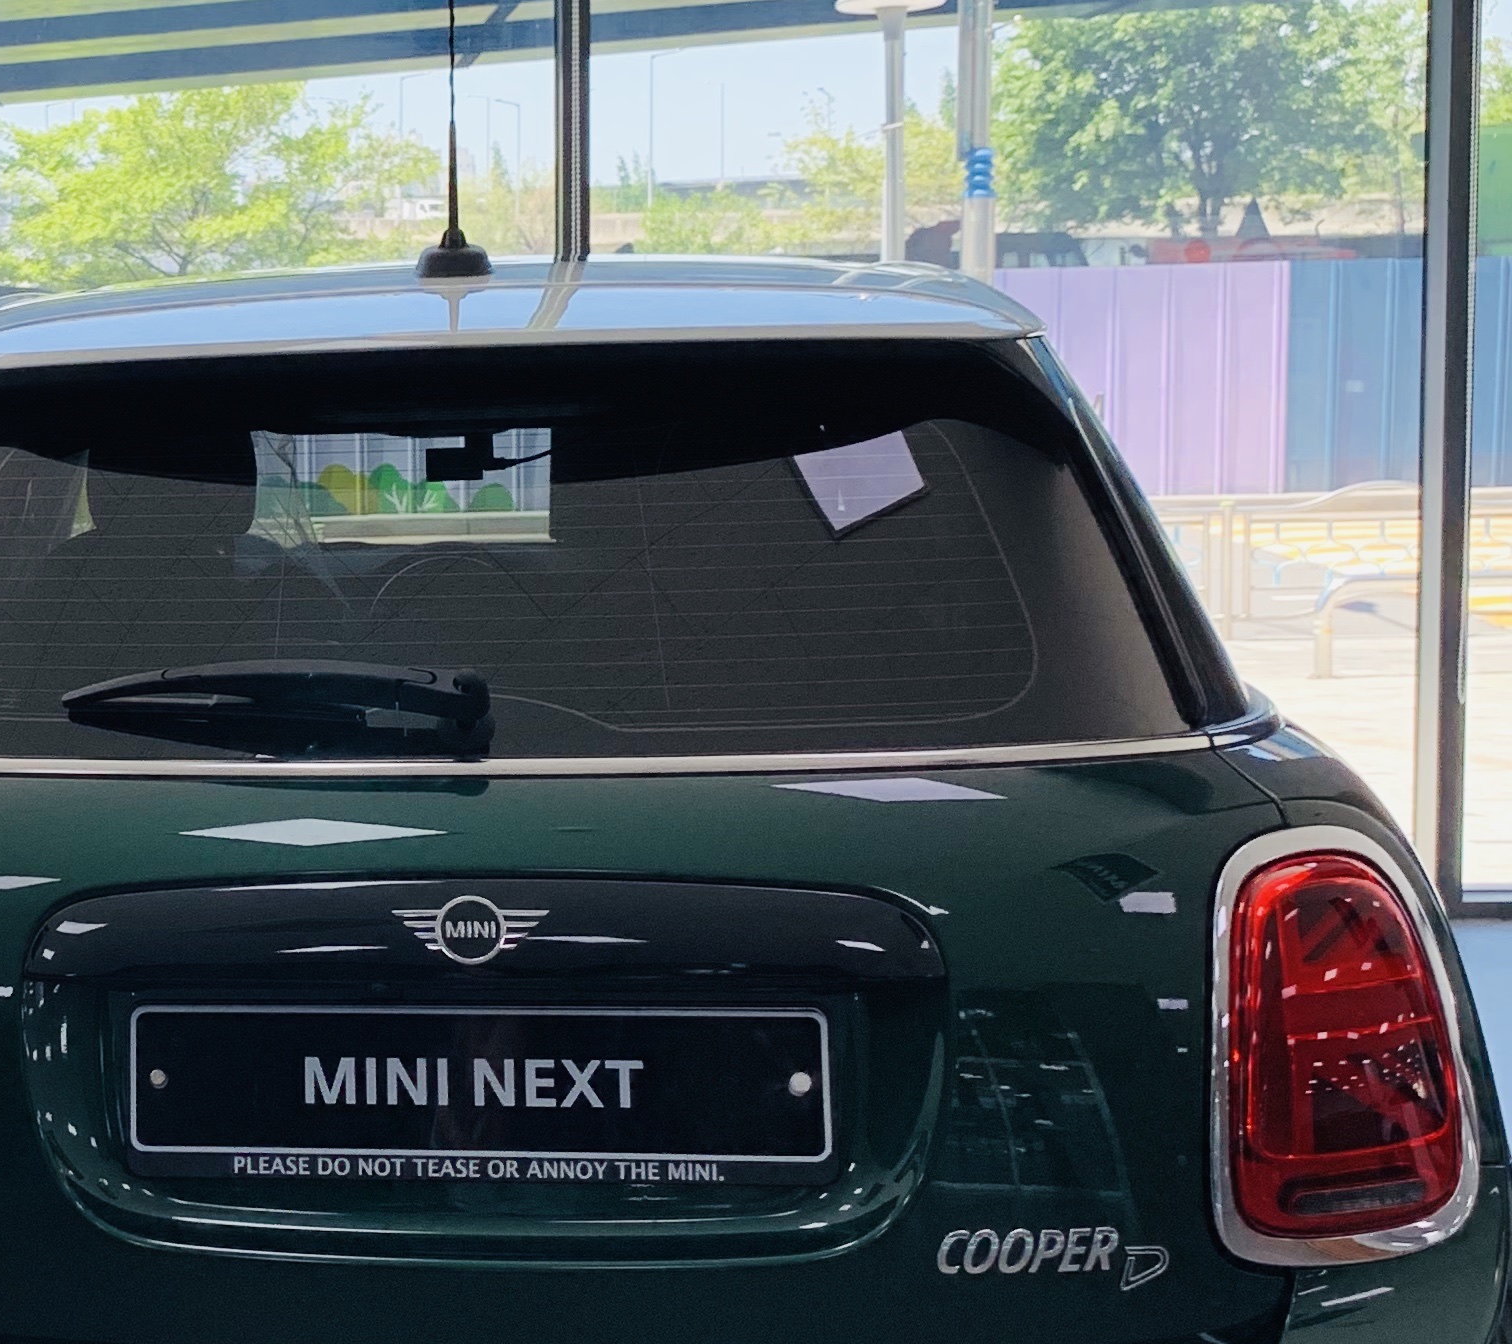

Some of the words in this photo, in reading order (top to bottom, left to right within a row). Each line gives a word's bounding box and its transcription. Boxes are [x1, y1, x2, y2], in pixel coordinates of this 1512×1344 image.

[445, 920, 496, 939] MINI
[303, 1055, 449, 1107] MINI
[472, 1057, 644, 1109] NEXT
[232, 1155, 311, 1176] PLEASE
[316, 1157, 351, 1177] DO
[357, 1157, 406, 1177] NOT
[411, 1158, 481, 1178] TEASE
[487, 1159, 520, 1179] OR
[526, 1160, 608, 1180] ANNOY
[614, 1161, 661, 1181] THE
[667, 1162, 725, 1182] MINI.
[938, 1227, 1120, 1275] COOPER
[1119, 1245, 1170, 1292] D
